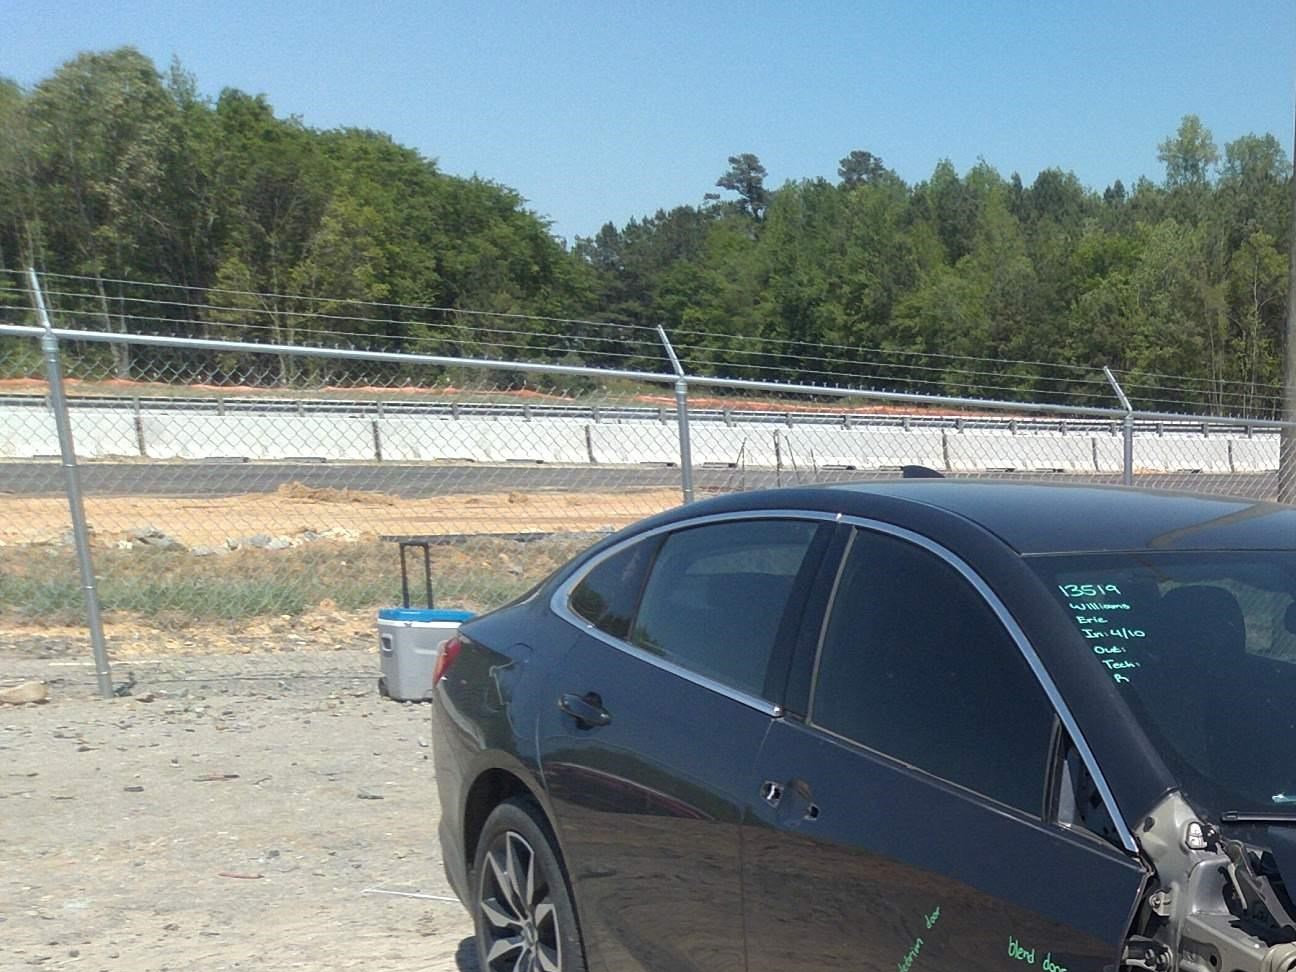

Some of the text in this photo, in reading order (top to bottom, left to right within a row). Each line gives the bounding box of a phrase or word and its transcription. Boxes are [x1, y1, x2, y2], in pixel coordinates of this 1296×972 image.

[1058, 584, 1122, 598] 13519
[1068, 602, 1131, 611] Williams
[1075, 615, 1109, 624] Eric
[1007, 935, 1036, 965] blend
